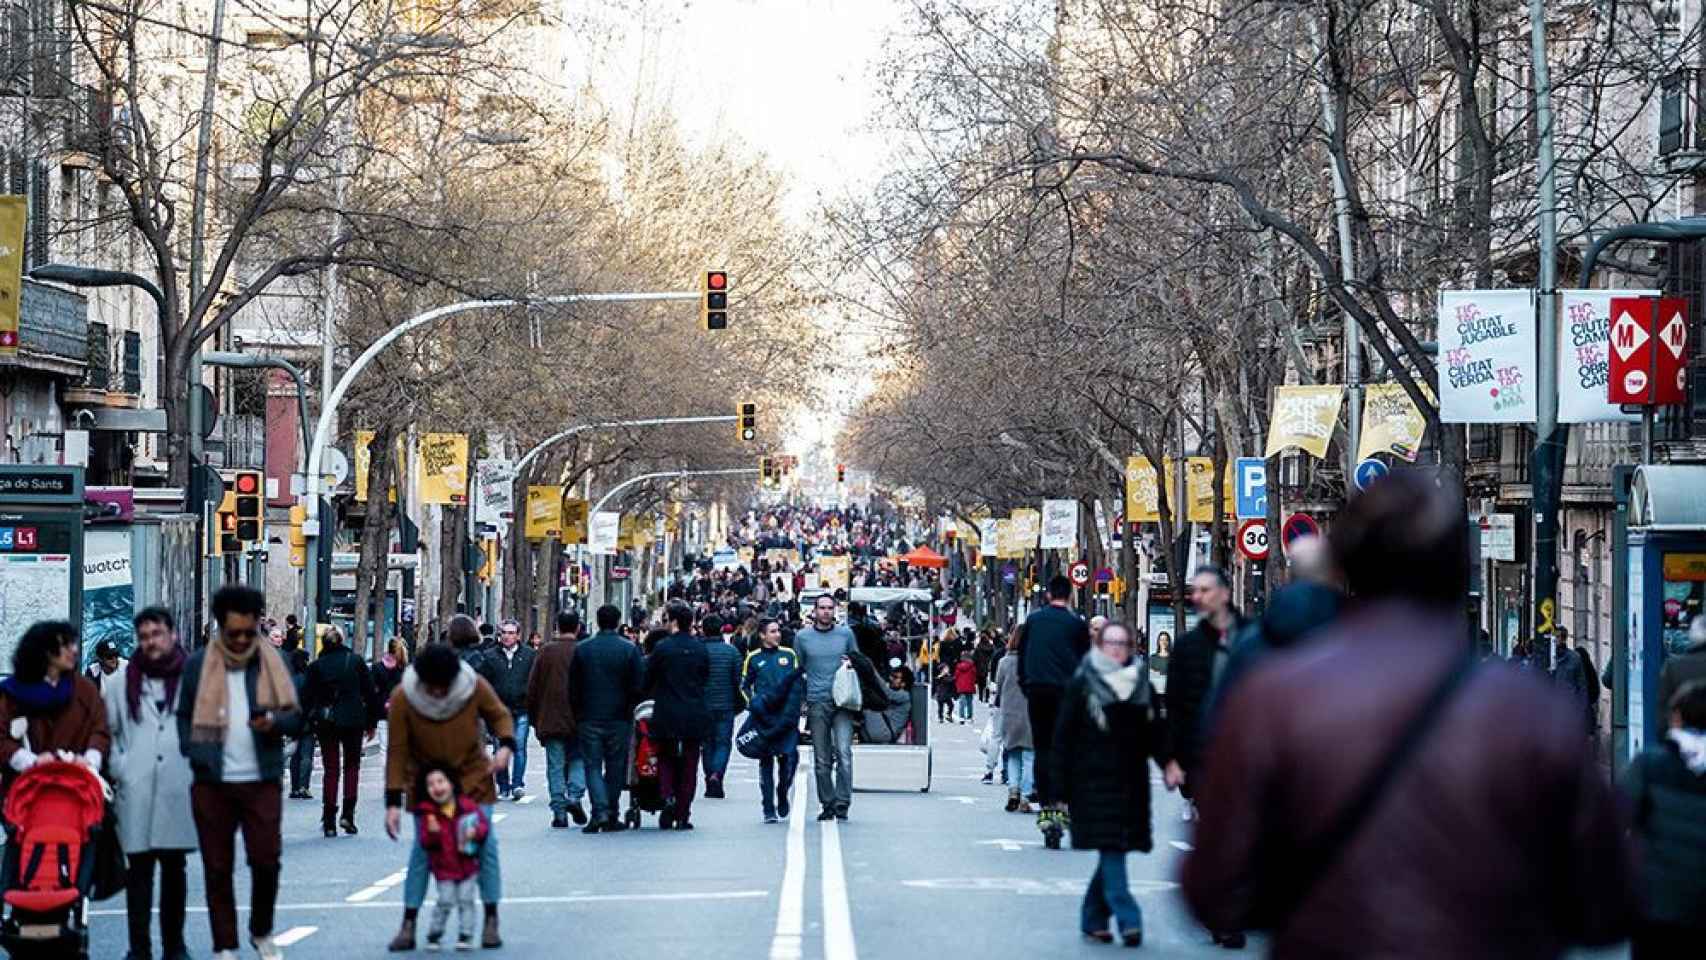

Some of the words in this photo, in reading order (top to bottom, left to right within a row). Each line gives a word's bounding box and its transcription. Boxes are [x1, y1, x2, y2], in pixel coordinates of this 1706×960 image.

[1568, 302, 1592, 315] TIC
[1457, 315, 1502, 335] CIUTAT
[1460, 323, 1518, 346] JUGABLE
[1618, 324, 1634, 347] M
[1671, 324, 1683, 346] M
[1448, 358, 1493, 378] CIUTAT
[1496, 366, 1518, 377] TIC
[1449, 370, 1495, 389] VERDA
[14, 478, 30, 489] de
[31, 478, 64, 490] Sants
[1245, 466, 1266, 497] P
[18, 531, 34, 545] L1
[1246, 531, 1268, 546] 30
